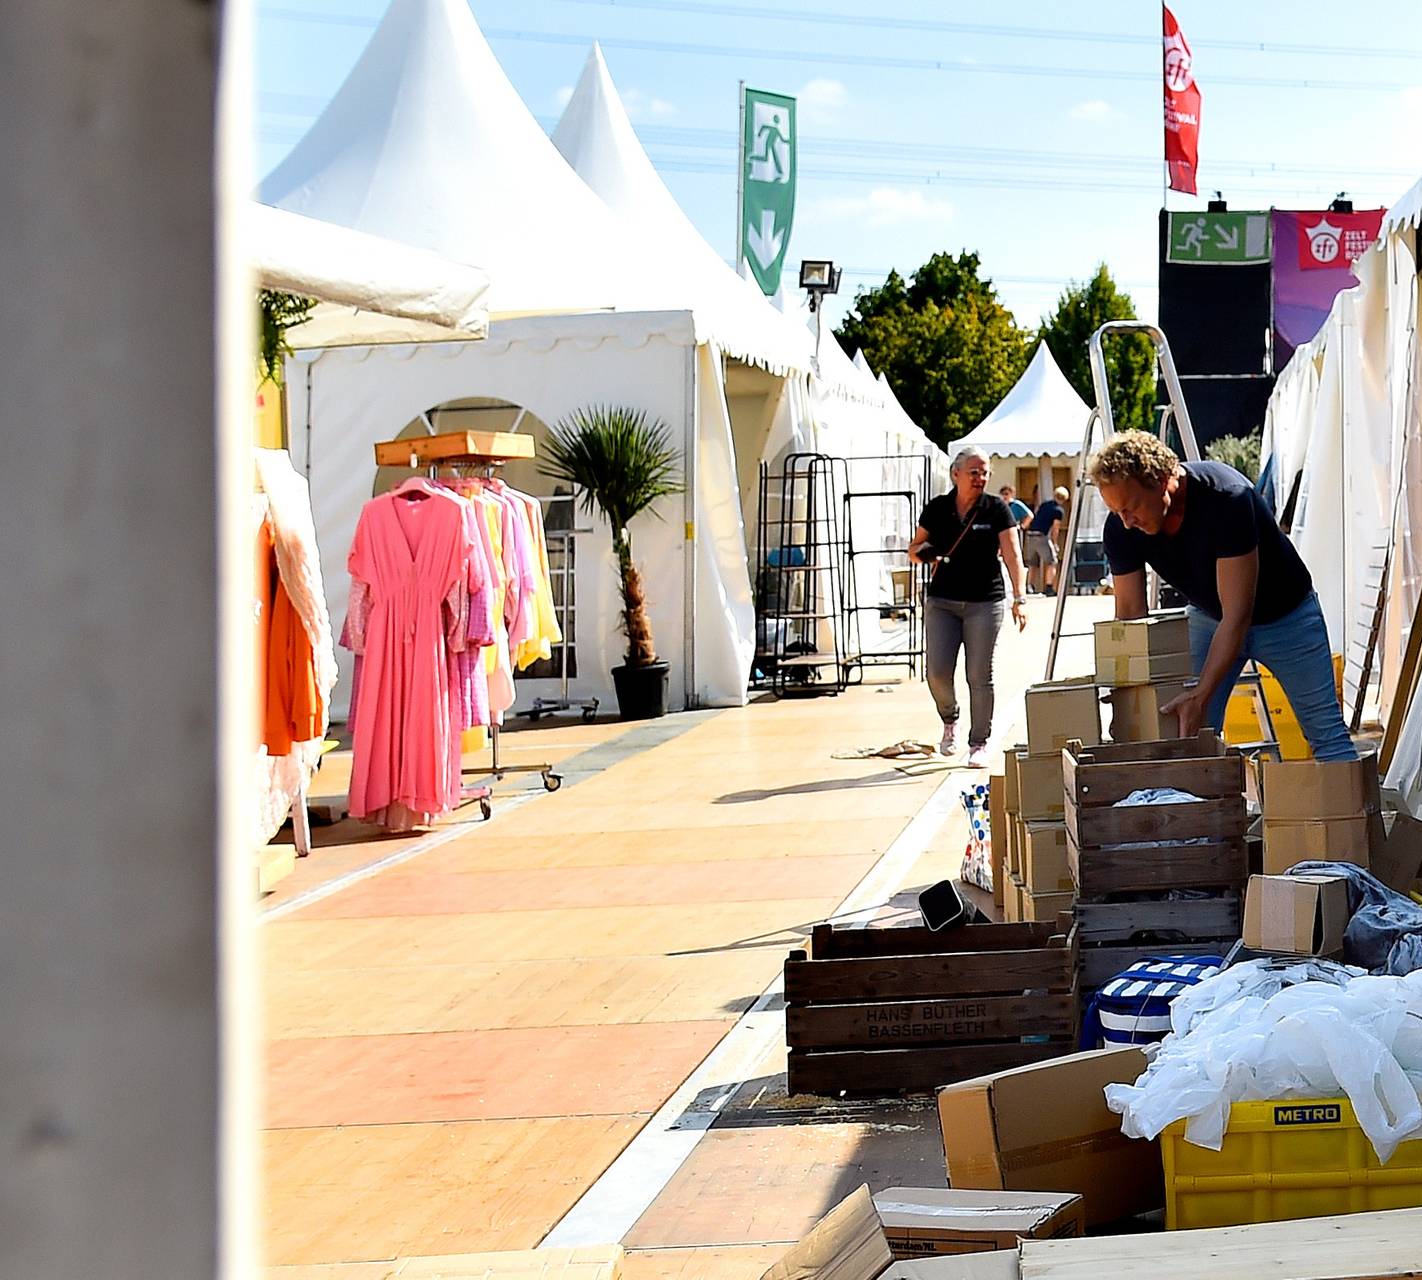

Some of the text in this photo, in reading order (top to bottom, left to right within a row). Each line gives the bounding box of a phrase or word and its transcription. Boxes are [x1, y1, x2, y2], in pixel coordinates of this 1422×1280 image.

[866, 1005, 912, 1022] HANS
[868, 1021, 985, 1039] BASSENFLETH
[1277, 1107, 1338, 1122] METRO
